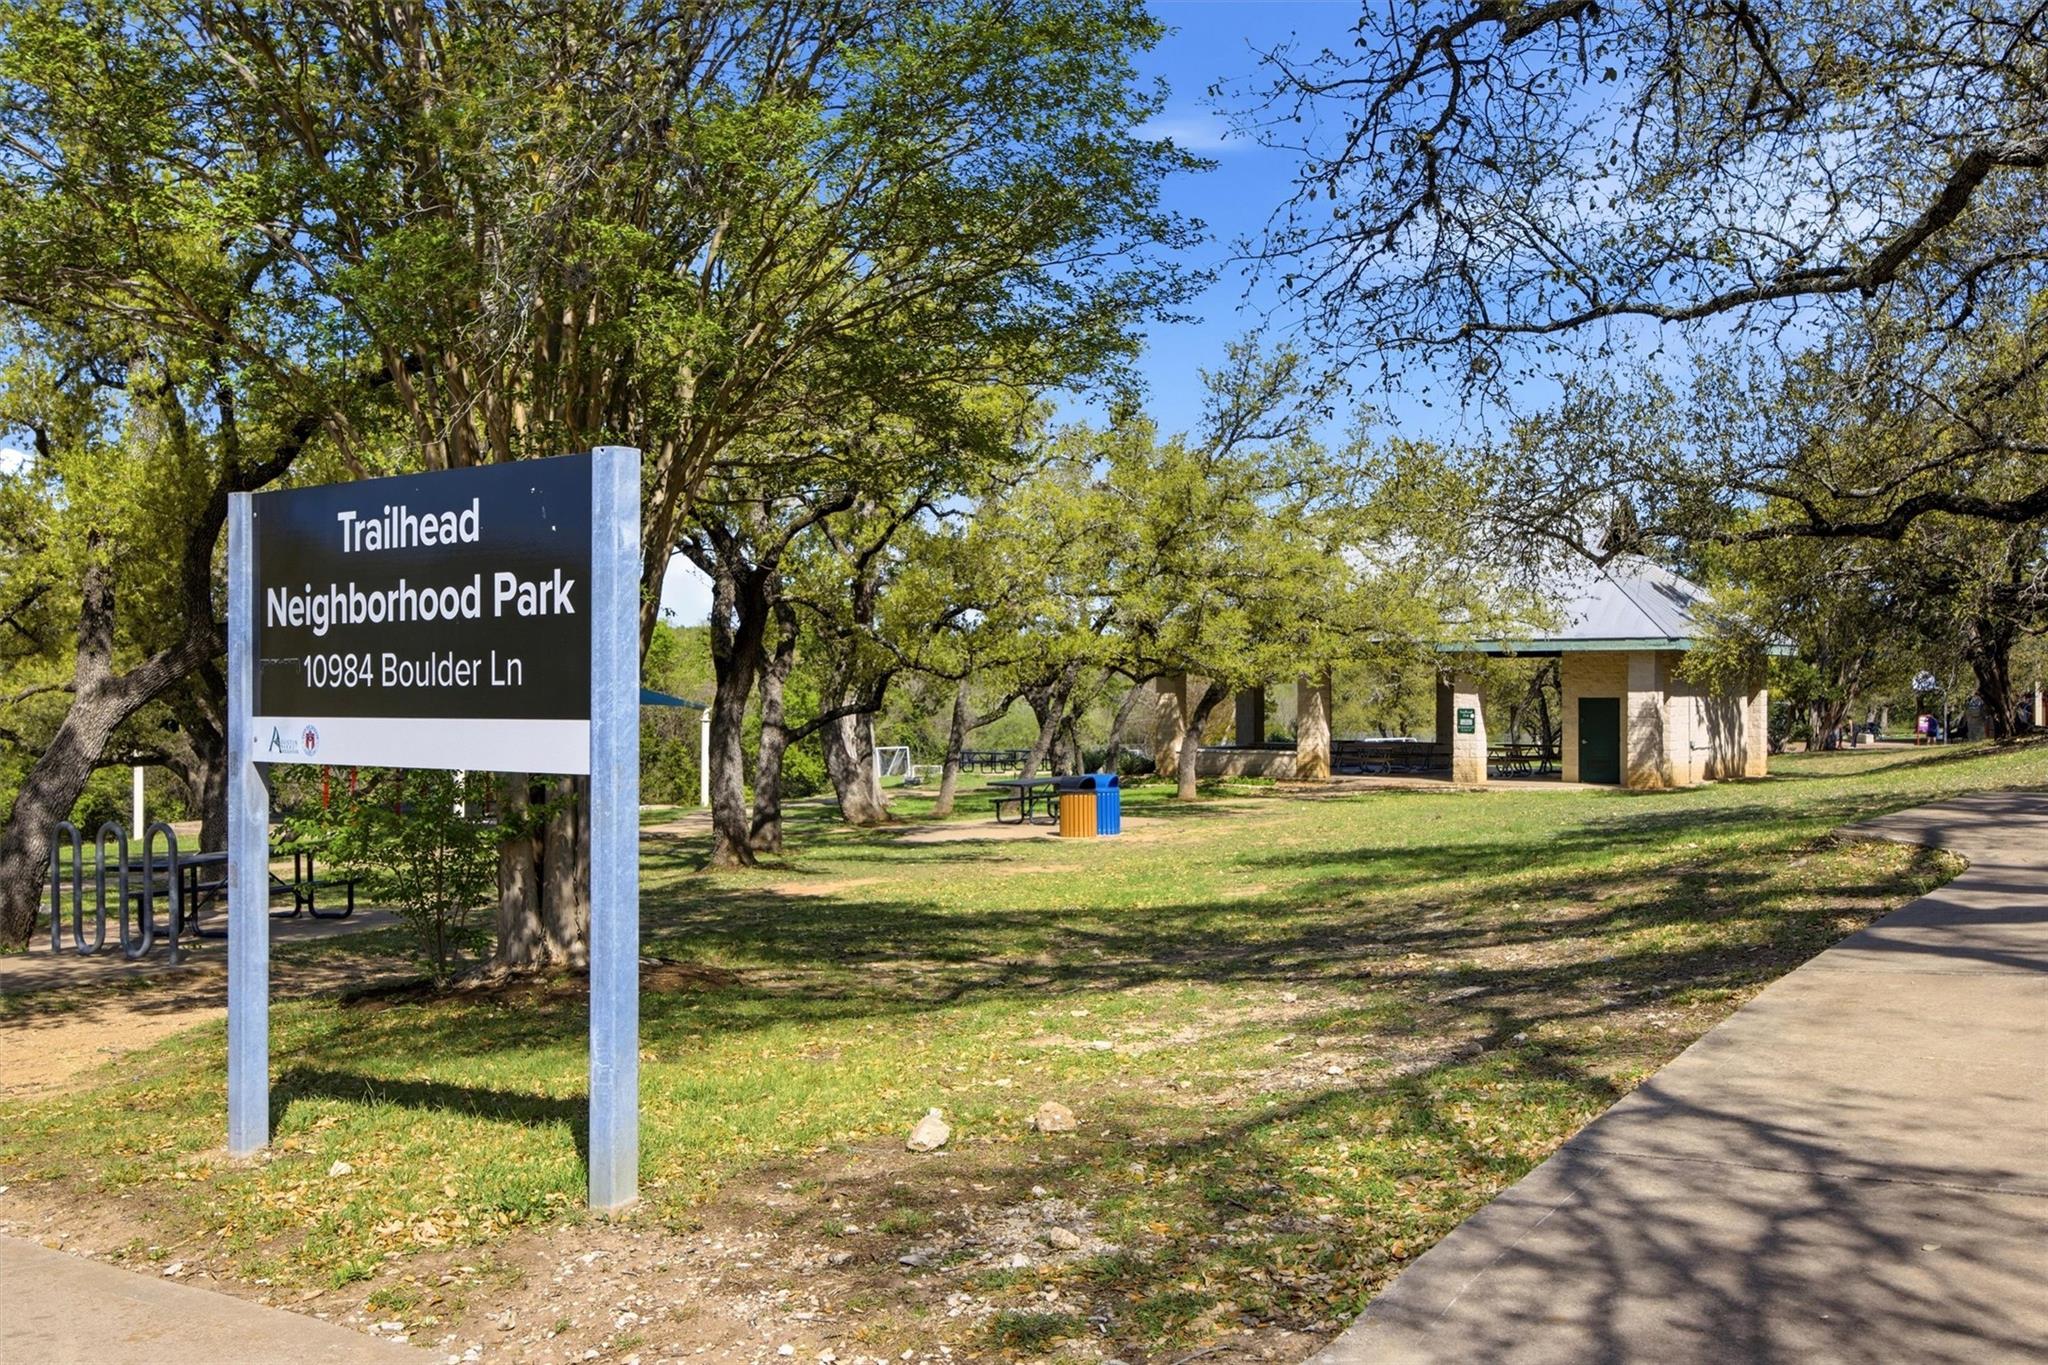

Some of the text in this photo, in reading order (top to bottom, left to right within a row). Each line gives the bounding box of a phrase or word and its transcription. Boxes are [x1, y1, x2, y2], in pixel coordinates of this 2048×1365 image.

[337, 498, 480, 553] Trailhead
[266, 568, 576, 637] Neighborhood Park
[303, 649, 523, 688] 10984 Boulder Ln
